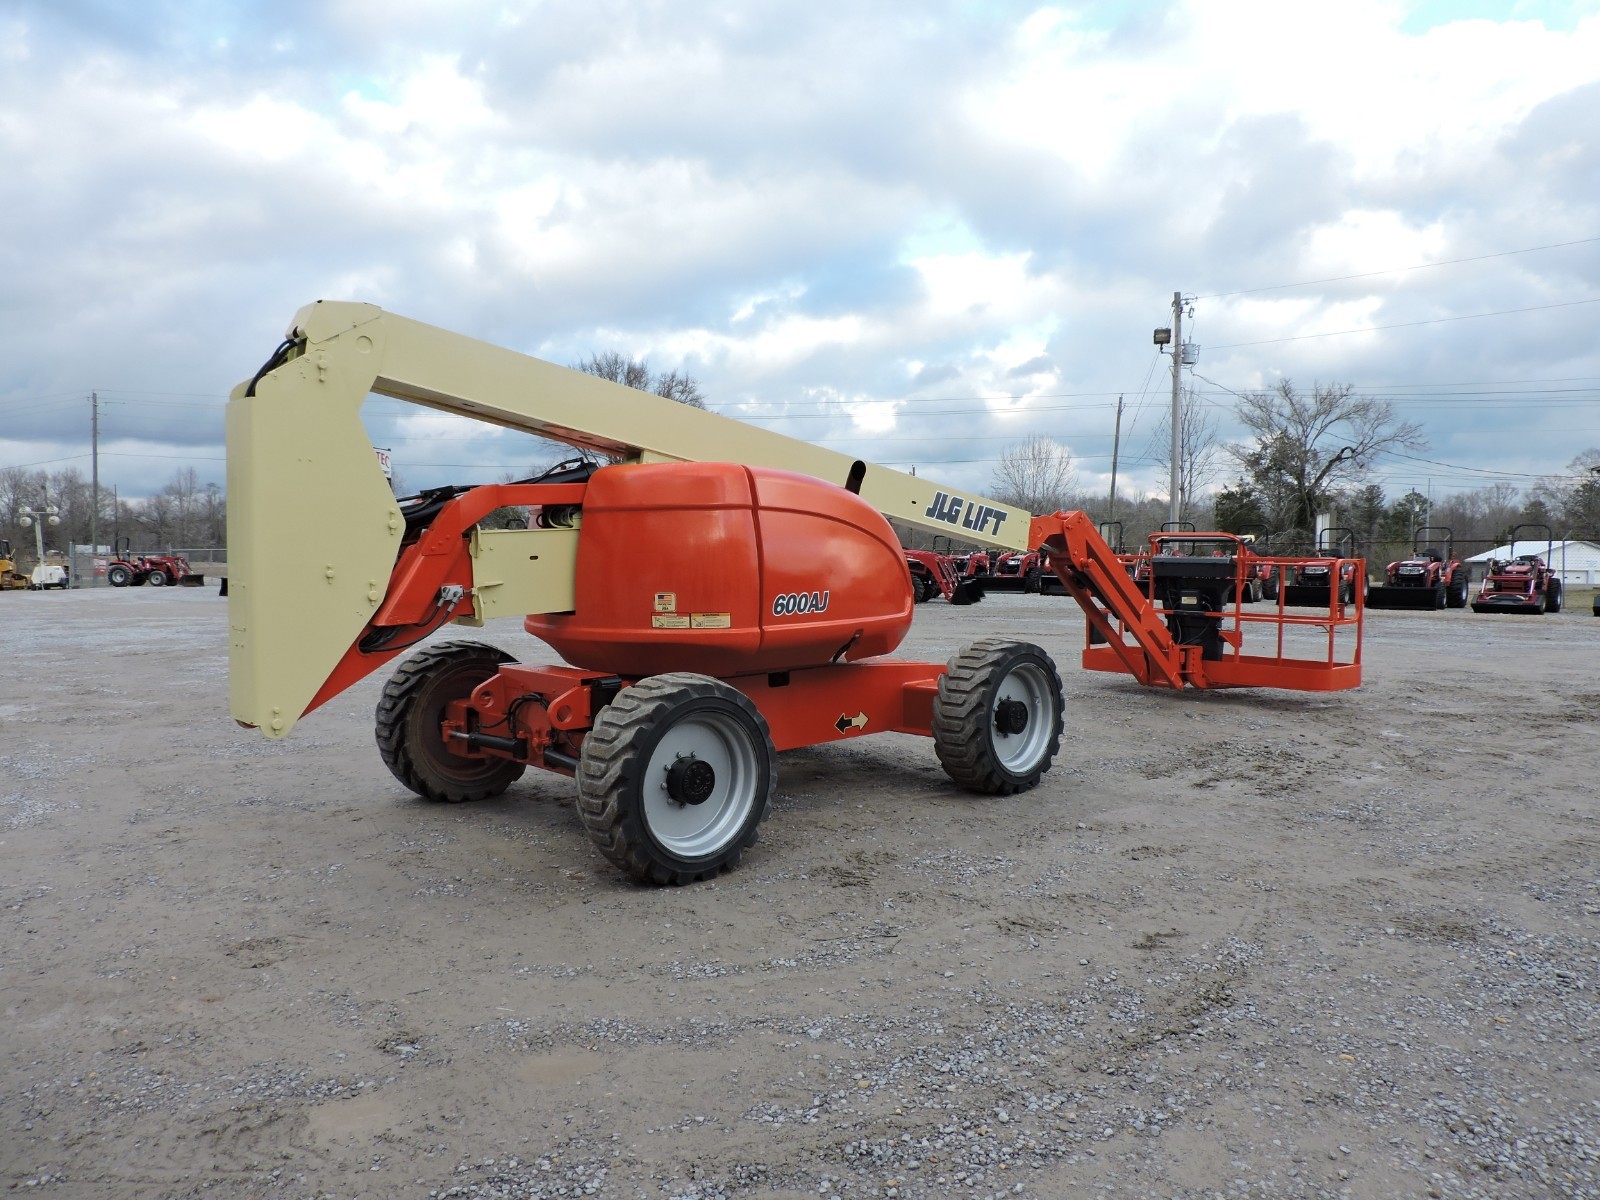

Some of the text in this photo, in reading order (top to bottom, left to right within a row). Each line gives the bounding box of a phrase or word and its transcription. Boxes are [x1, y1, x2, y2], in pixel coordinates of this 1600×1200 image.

[925, 491, 1008, 536] JLG LIFT
[773, 591, 829, 616] 600AJ
